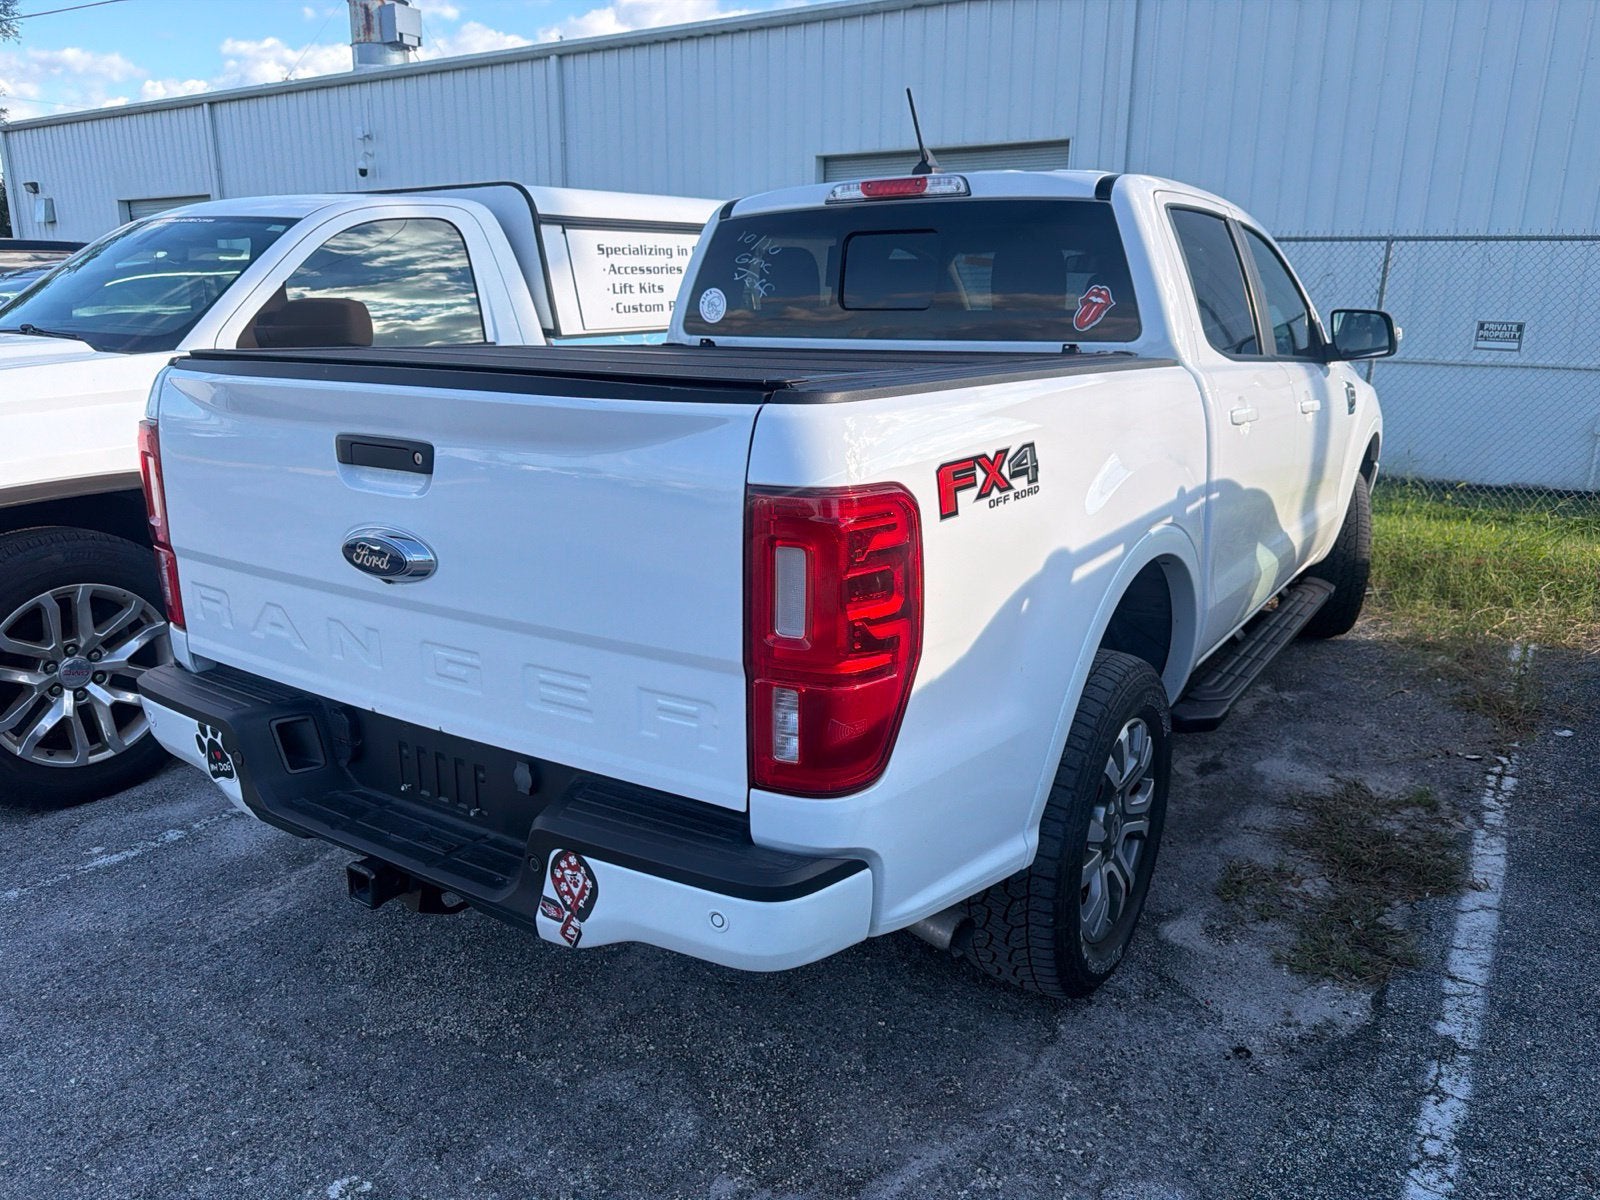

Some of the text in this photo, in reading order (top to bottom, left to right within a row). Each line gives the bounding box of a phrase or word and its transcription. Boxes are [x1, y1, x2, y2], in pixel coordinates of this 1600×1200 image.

[597, 243, 673, 259] Specializing
[677, 245, 688, 256] in
[608, 264, 683, 275] Accessories
[612, 282, 664, 295] Lift Kits
[615, 302, 664, 314] Custom
[1478, 330, 1521, 338] PROPERTY
[1484, 324, 1518, 332] PRIVATE
[936, 441, 1039, 522] FX4
[988, 485, 1040, 509] OFF ROAD
[352, 541, 391, 570] Ford
[190, 581, 719, 752] RANGER
[218, 761, 231, 772] DOG
